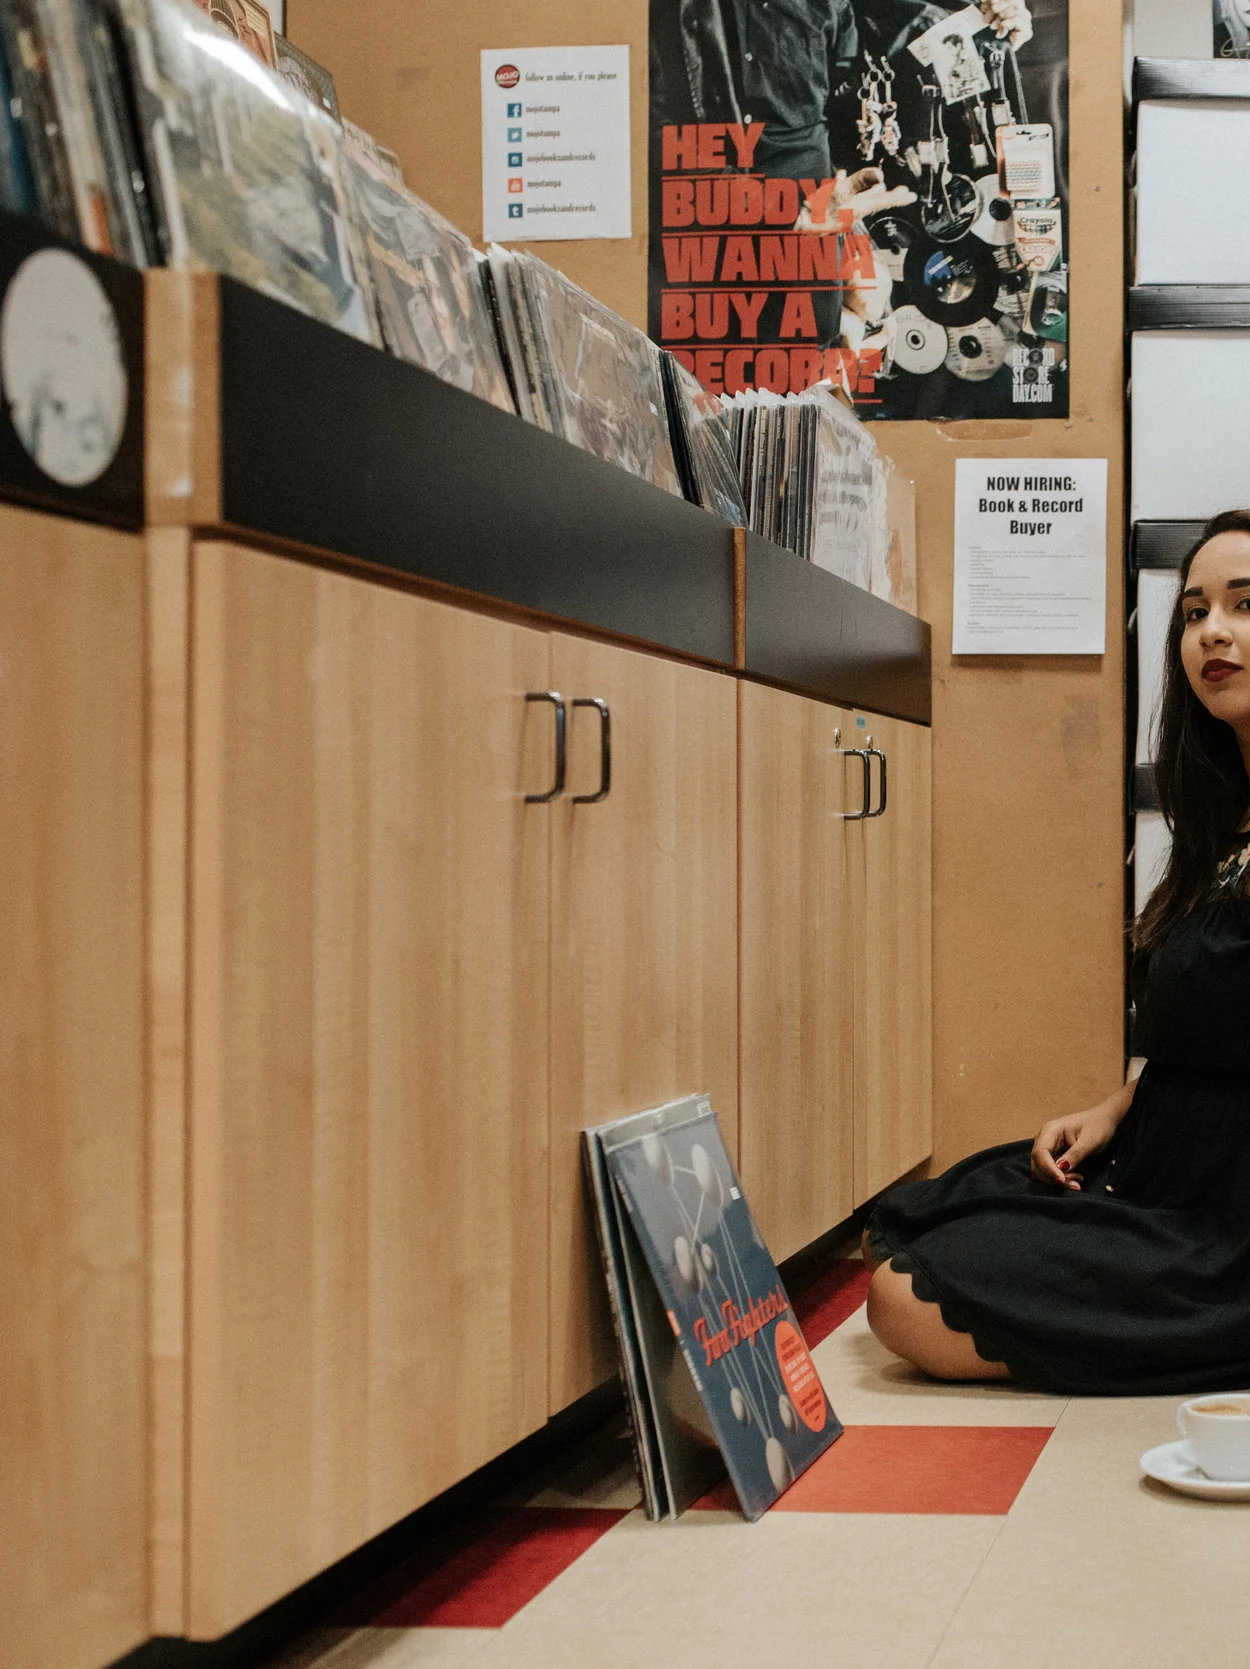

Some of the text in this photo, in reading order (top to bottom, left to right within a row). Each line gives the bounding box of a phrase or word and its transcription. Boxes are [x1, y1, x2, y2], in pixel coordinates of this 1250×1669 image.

[525, 72, 544, 82] follow
[584, 73, 595, 82] you
[597, 71, 617, 82] please
[662, 122, 766, 170] HEY
[662, 178, 854, 231] BUDDY,
[662, 235, 876, 282] WANNA
[661, 292, 818, 339] BUY A
[979, 498, 1083, 513] Book & Record
[987, 476, 1077, 491] NOW HIRING:
[1009, 520, 1052, 536] Buyer
[693, 1283, 789, 1367] Foo Fighters
